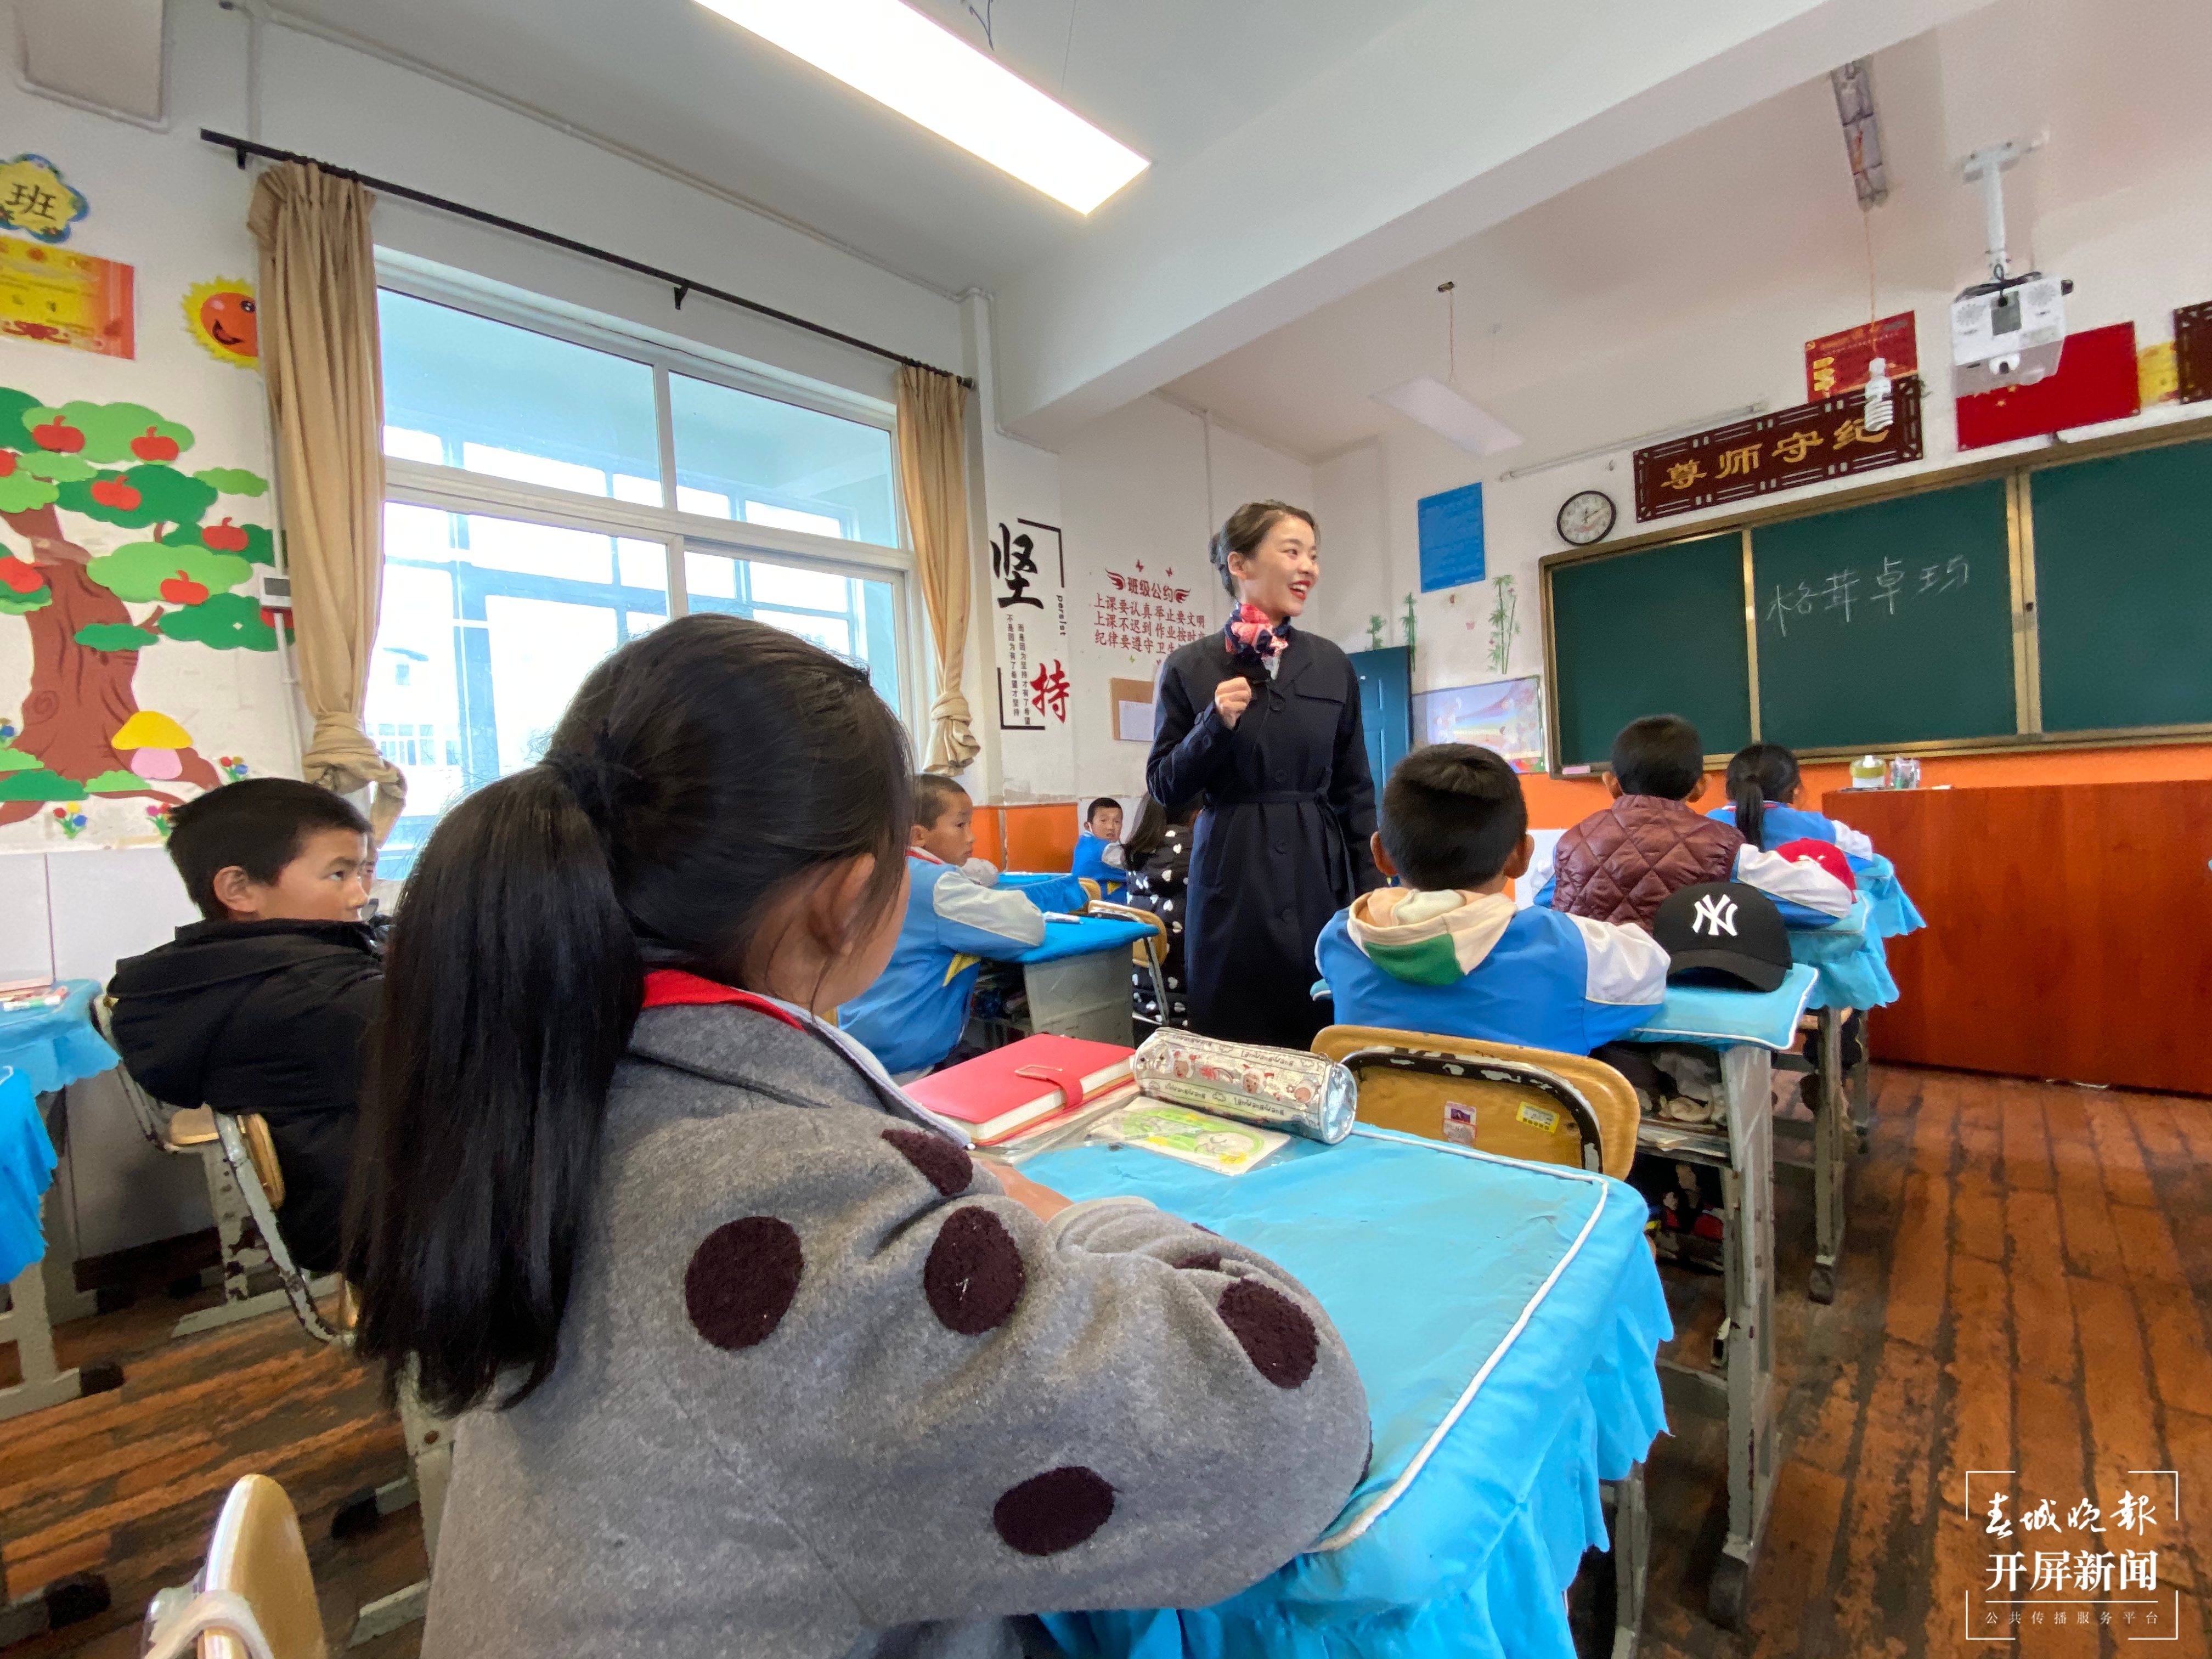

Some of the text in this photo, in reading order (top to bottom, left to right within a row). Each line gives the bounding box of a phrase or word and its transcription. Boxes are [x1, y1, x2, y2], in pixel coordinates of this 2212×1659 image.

[4, 183, 57, 221] 班
[1661, 418, 1889, 490] 尊师守纪
[989, 522, 1044, 610] 坚
[1127, 577, 1173, 602] 班级公约
[1094, 592, 1205, 629] 上课要认真 举止要文明
[1094, 611, 1152, 637] 上课不迟到
[1094, 629, 1154, 654] 纪律要遵守
[1006, 614, 1019, 716] 不是因为有了希望才坚持
[1030, 658, 1070, 724] 持
[1692, 894, 1739, 936] NY
